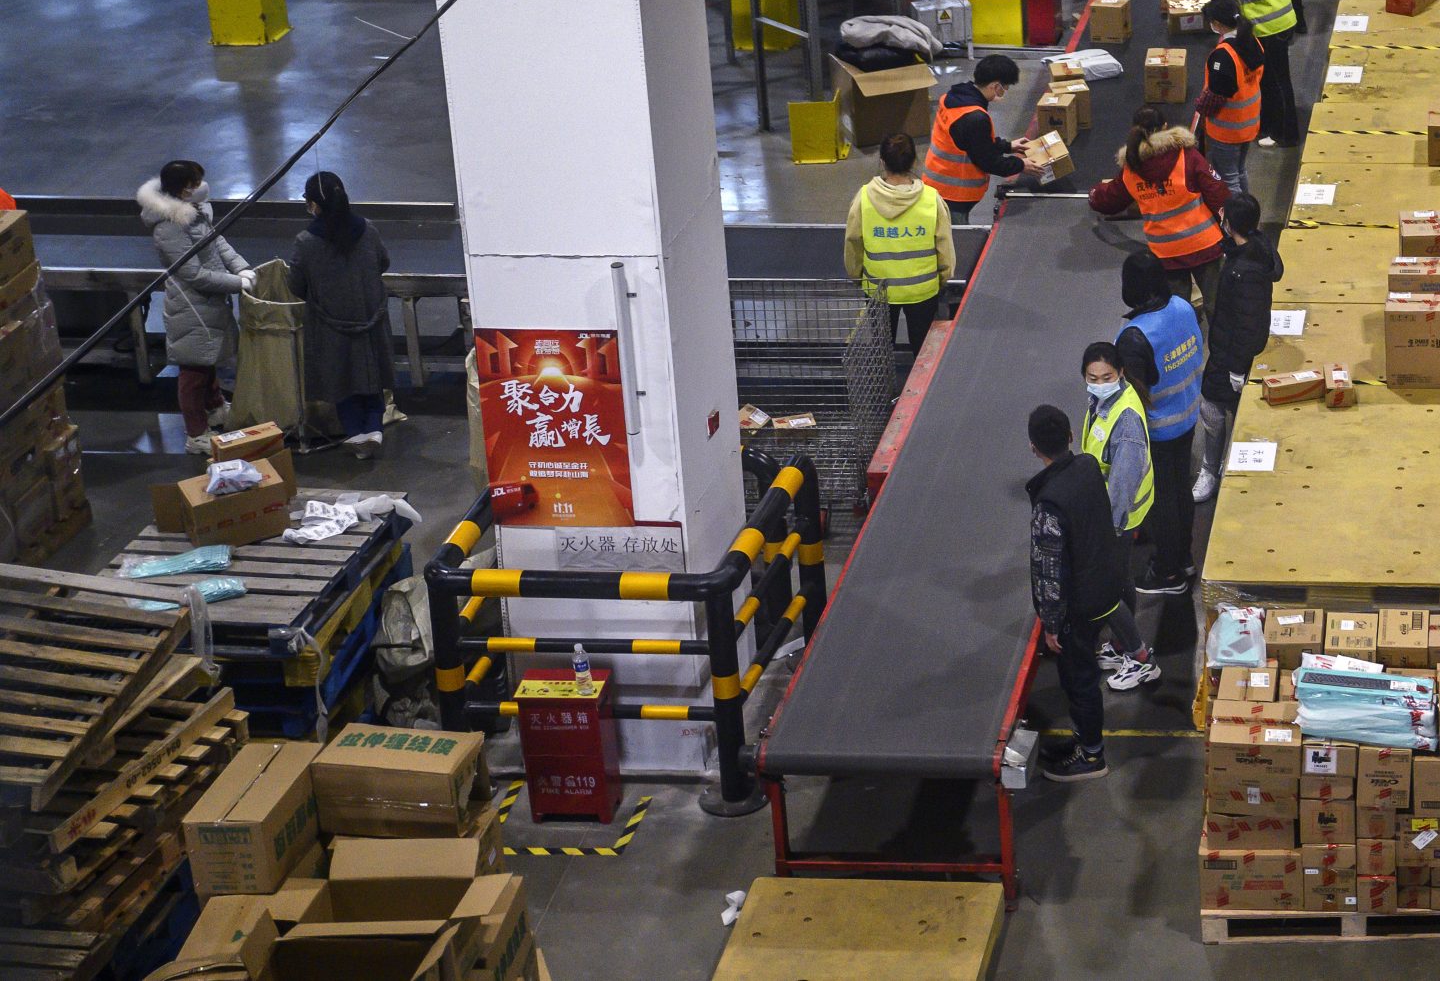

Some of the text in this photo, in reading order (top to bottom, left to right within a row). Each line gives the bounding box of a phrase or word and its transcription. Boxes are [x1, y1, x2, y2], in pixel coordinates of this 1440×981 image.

[873, 225, 927, 238] 超越人力
[500, 379, 583, 416] 聚合力
[491, 487, 506, 498] JDL
[560, 535, 679, 554] 灭火器 存放处
[530, 711, 589, 724] 灭火器箱
[336, 732, 459, 756] 拉伸缠绕膜
[576, 776, 596, 788] 119
[564, 787, 593, 795] ALARM
